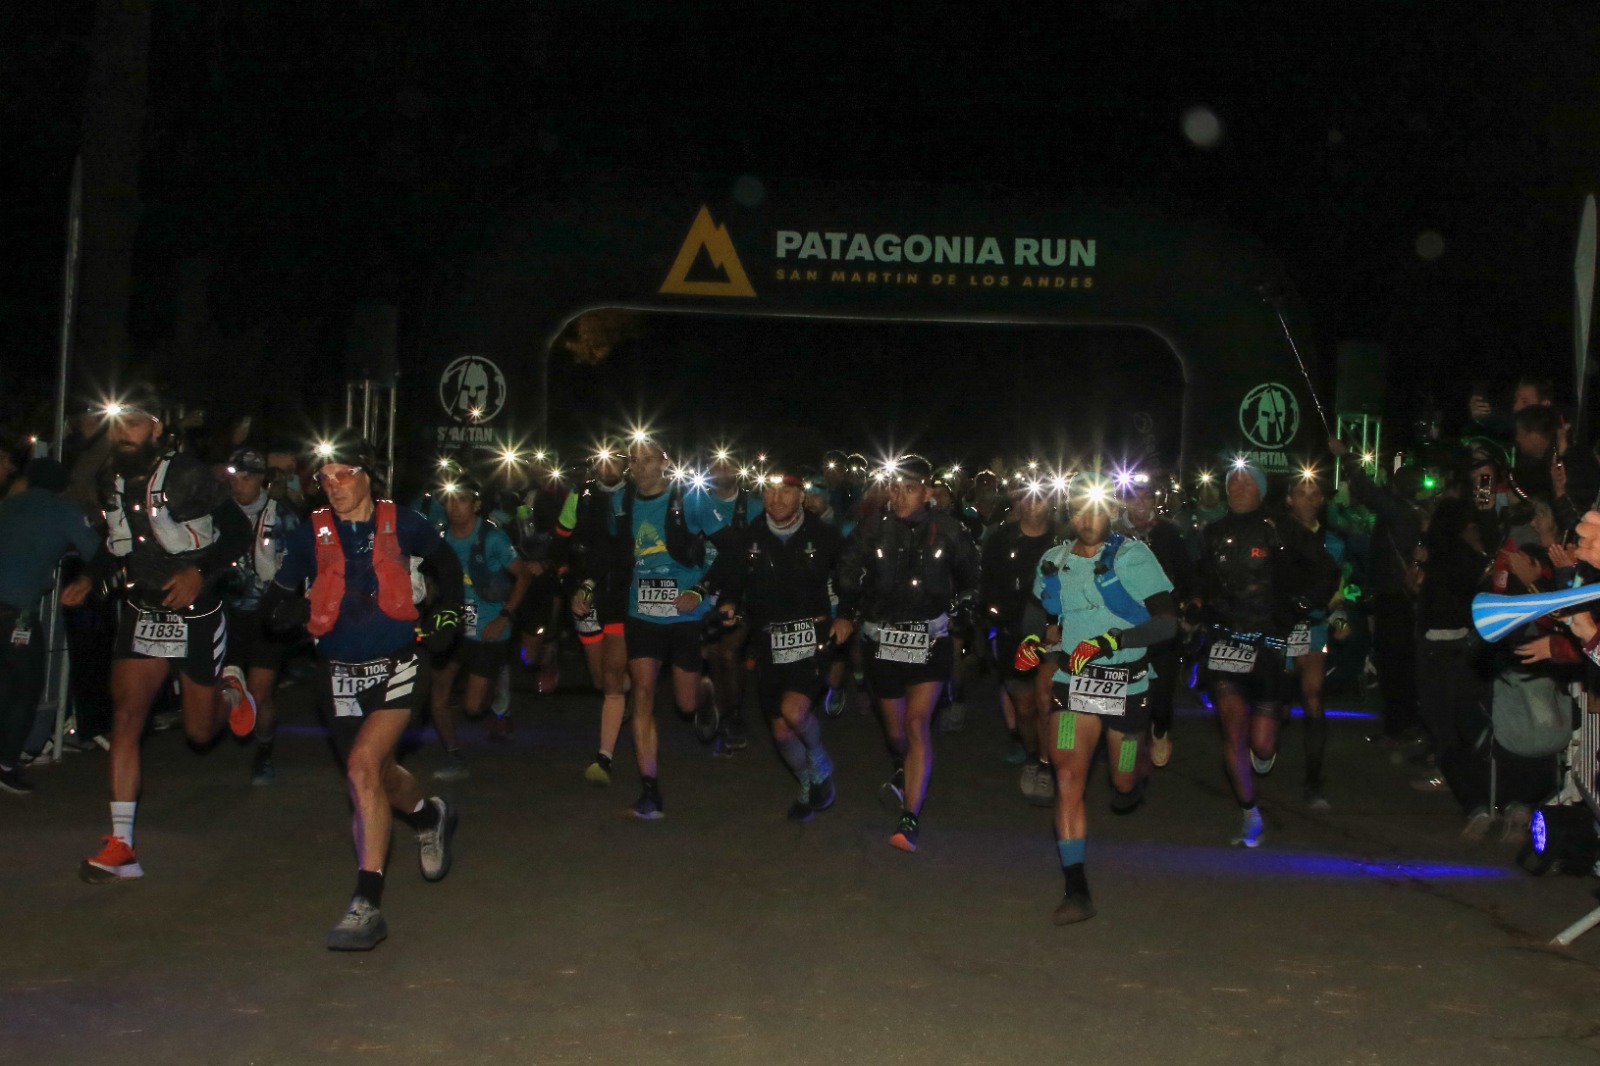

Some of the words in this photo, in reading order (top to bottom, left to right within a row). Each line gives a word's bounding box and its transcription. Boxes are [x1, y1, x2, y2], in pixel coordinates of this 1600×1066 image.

[776, 230, 1004, 265] PATAGONIA
[1014, 237, 1097, 267] RUN
[776, 269, 818, 281] SAN
[831, 271, 919, 284] MARTIN
[931, 274, 958, 285] DE
[970, 275, 1010, 286] LOS
[1022, 276, 1094, 288] ANDES
[641, 589, 677, 600] 11765
[140, 624, 185, 638] 11835
[885, 631, 927, 646] 11814
[774, 631, 813, 647] 11510
[1214, 647, 1252, 660] 11716
[1075, 678, 1126, 695] 11787
